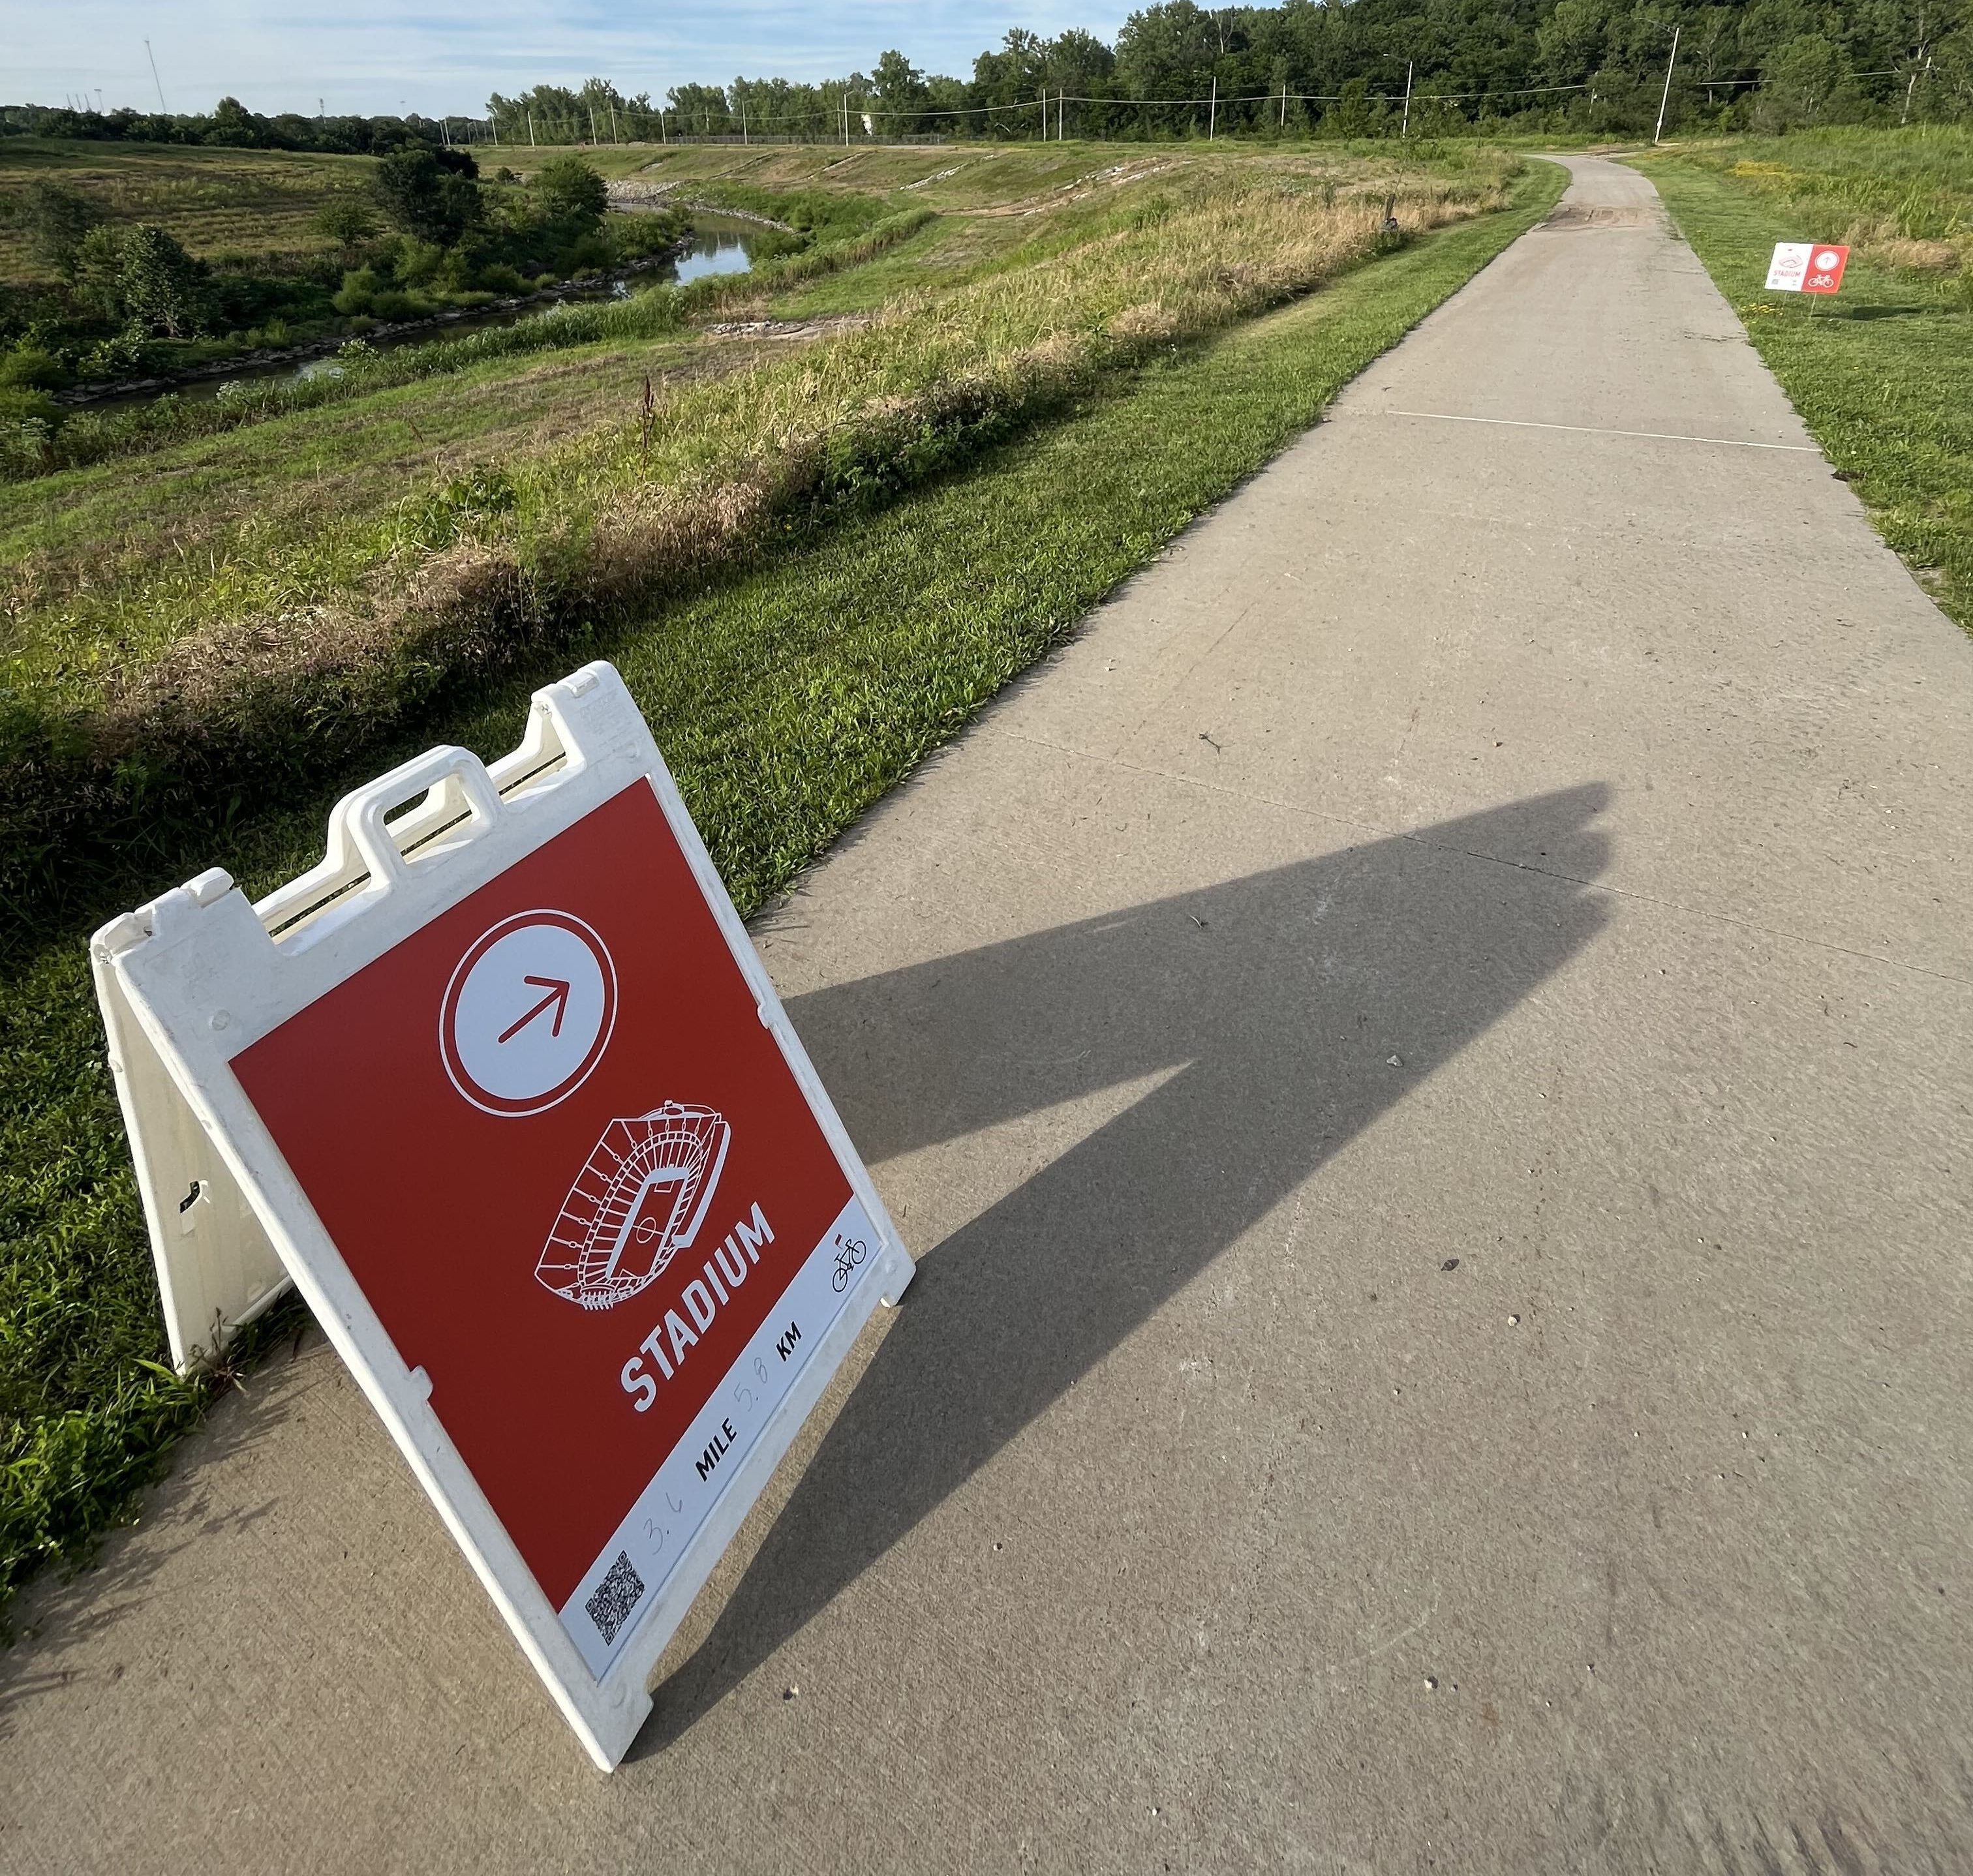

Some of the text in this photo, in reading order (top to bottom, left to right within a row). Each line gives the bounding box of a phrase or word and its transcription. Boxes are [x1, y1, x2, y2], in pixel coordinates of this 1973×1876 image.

[620, 1202, 775, 1412] STADIUM
[695, 1417, 737, 1482] MILE
[733, 1357, 768, 1412] 5.8
[776, 1321, 802, 1362] KM
